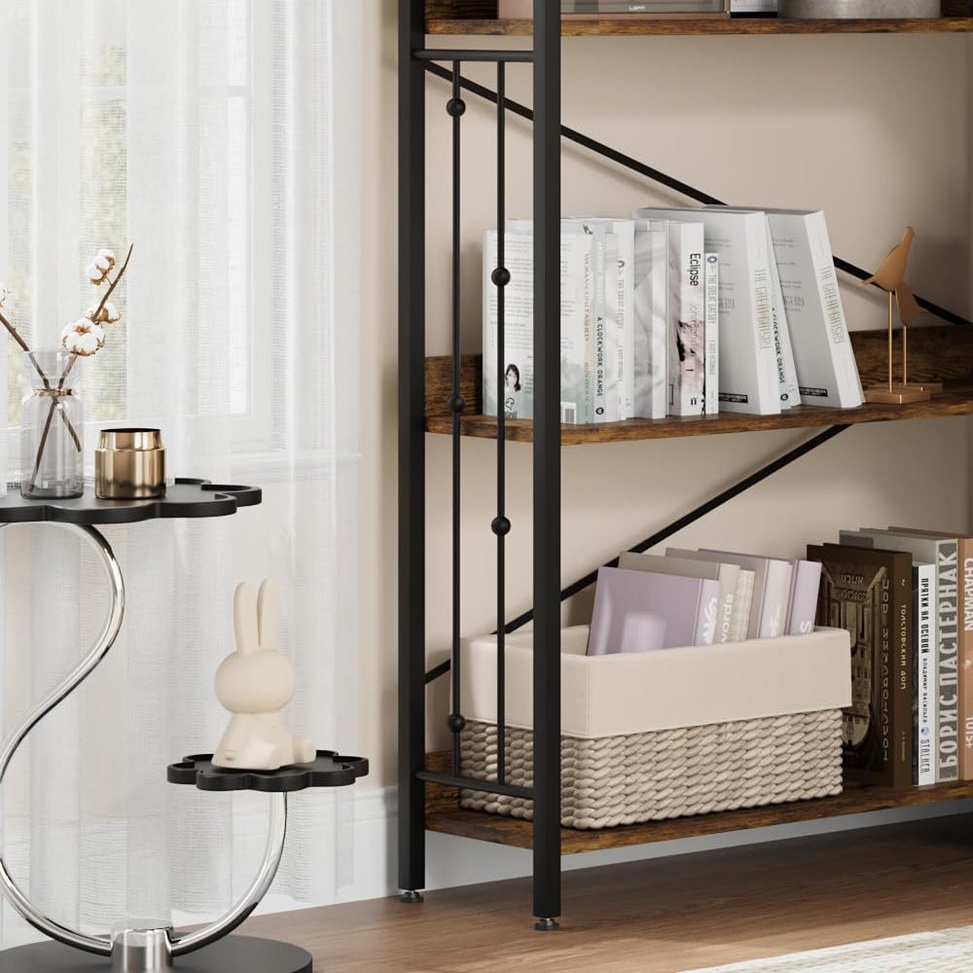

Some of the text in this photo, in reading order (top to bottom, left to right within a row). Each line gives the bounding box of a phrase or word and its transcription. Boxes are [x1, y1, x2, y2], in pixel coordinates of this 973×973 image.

[688, 253, 701, 287] Eclipse
[920, 611, 929, 621] НА
[920, 624, 930, 654] ОСЕВОЙ
[939, 552, 958, 768] БОРИС ПАСТЕРНАК
